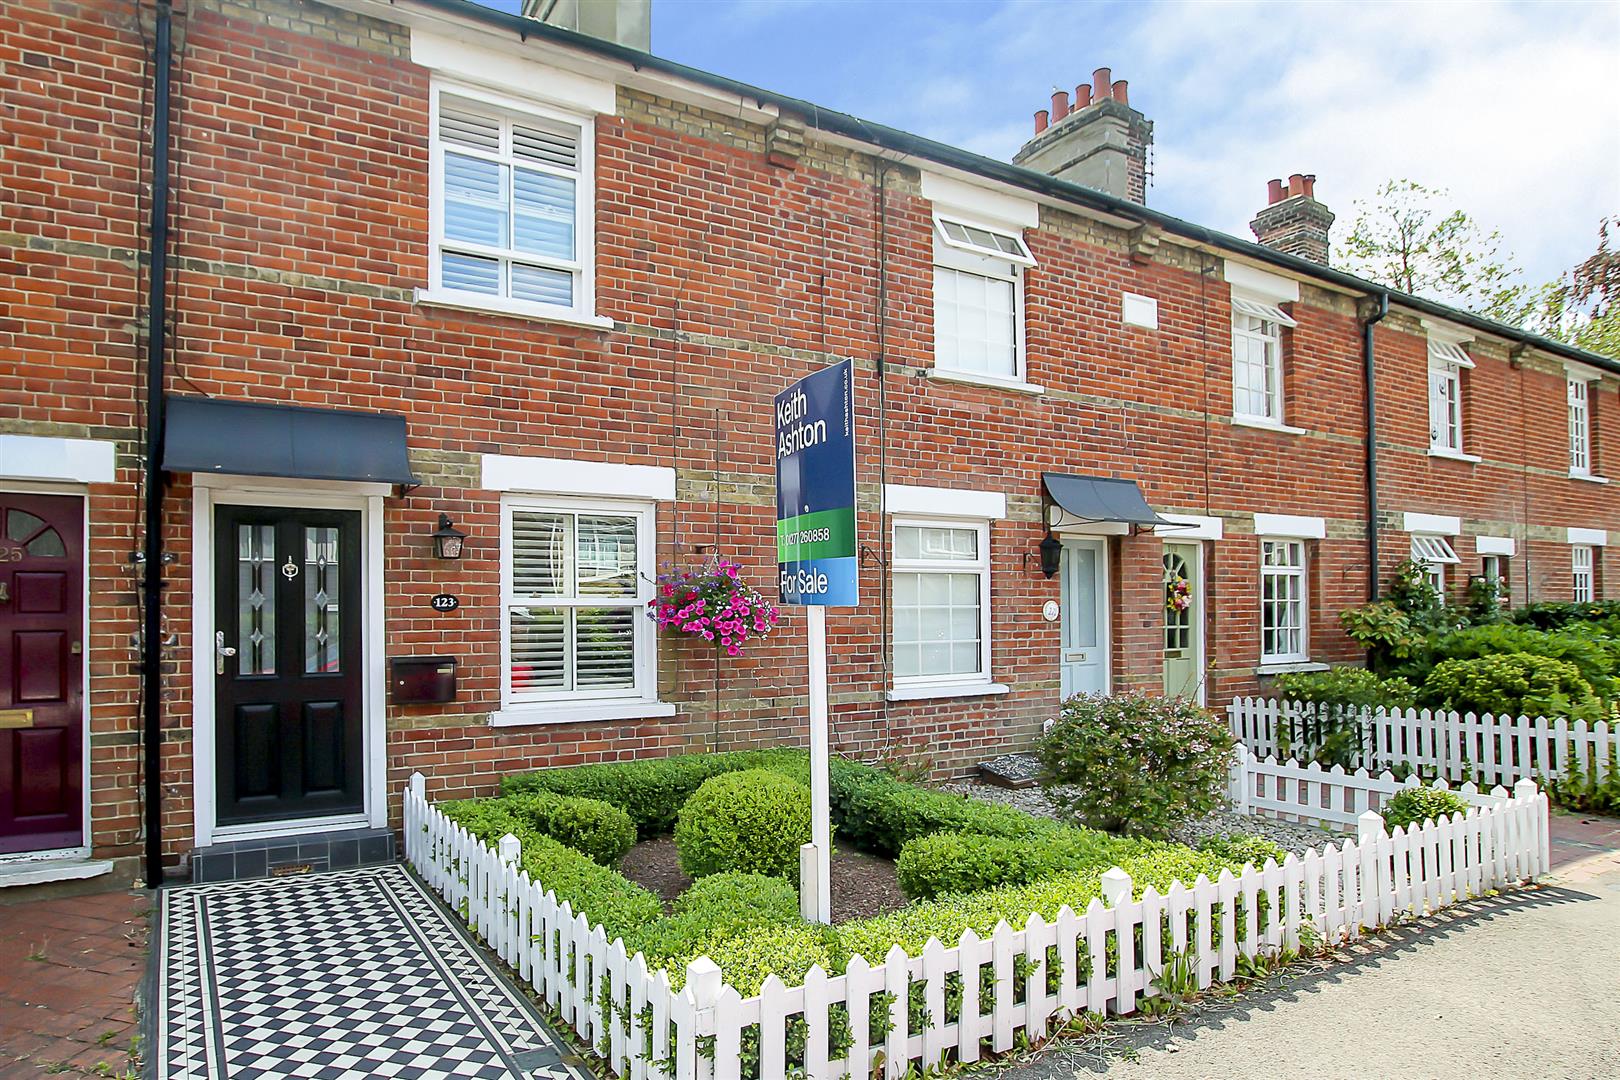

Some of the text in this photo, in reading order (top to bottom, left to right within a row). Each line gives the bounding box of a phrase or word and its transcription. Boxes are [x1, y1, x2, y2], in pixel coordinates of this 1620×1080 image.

[777, 388, 807, 429] Keith
[778, 419, 826, 459] Ashton
[800, 527, 829, 543] 260858
[780, 567, 827, 594] For Sale
[435, 597, 454, 607] 123
